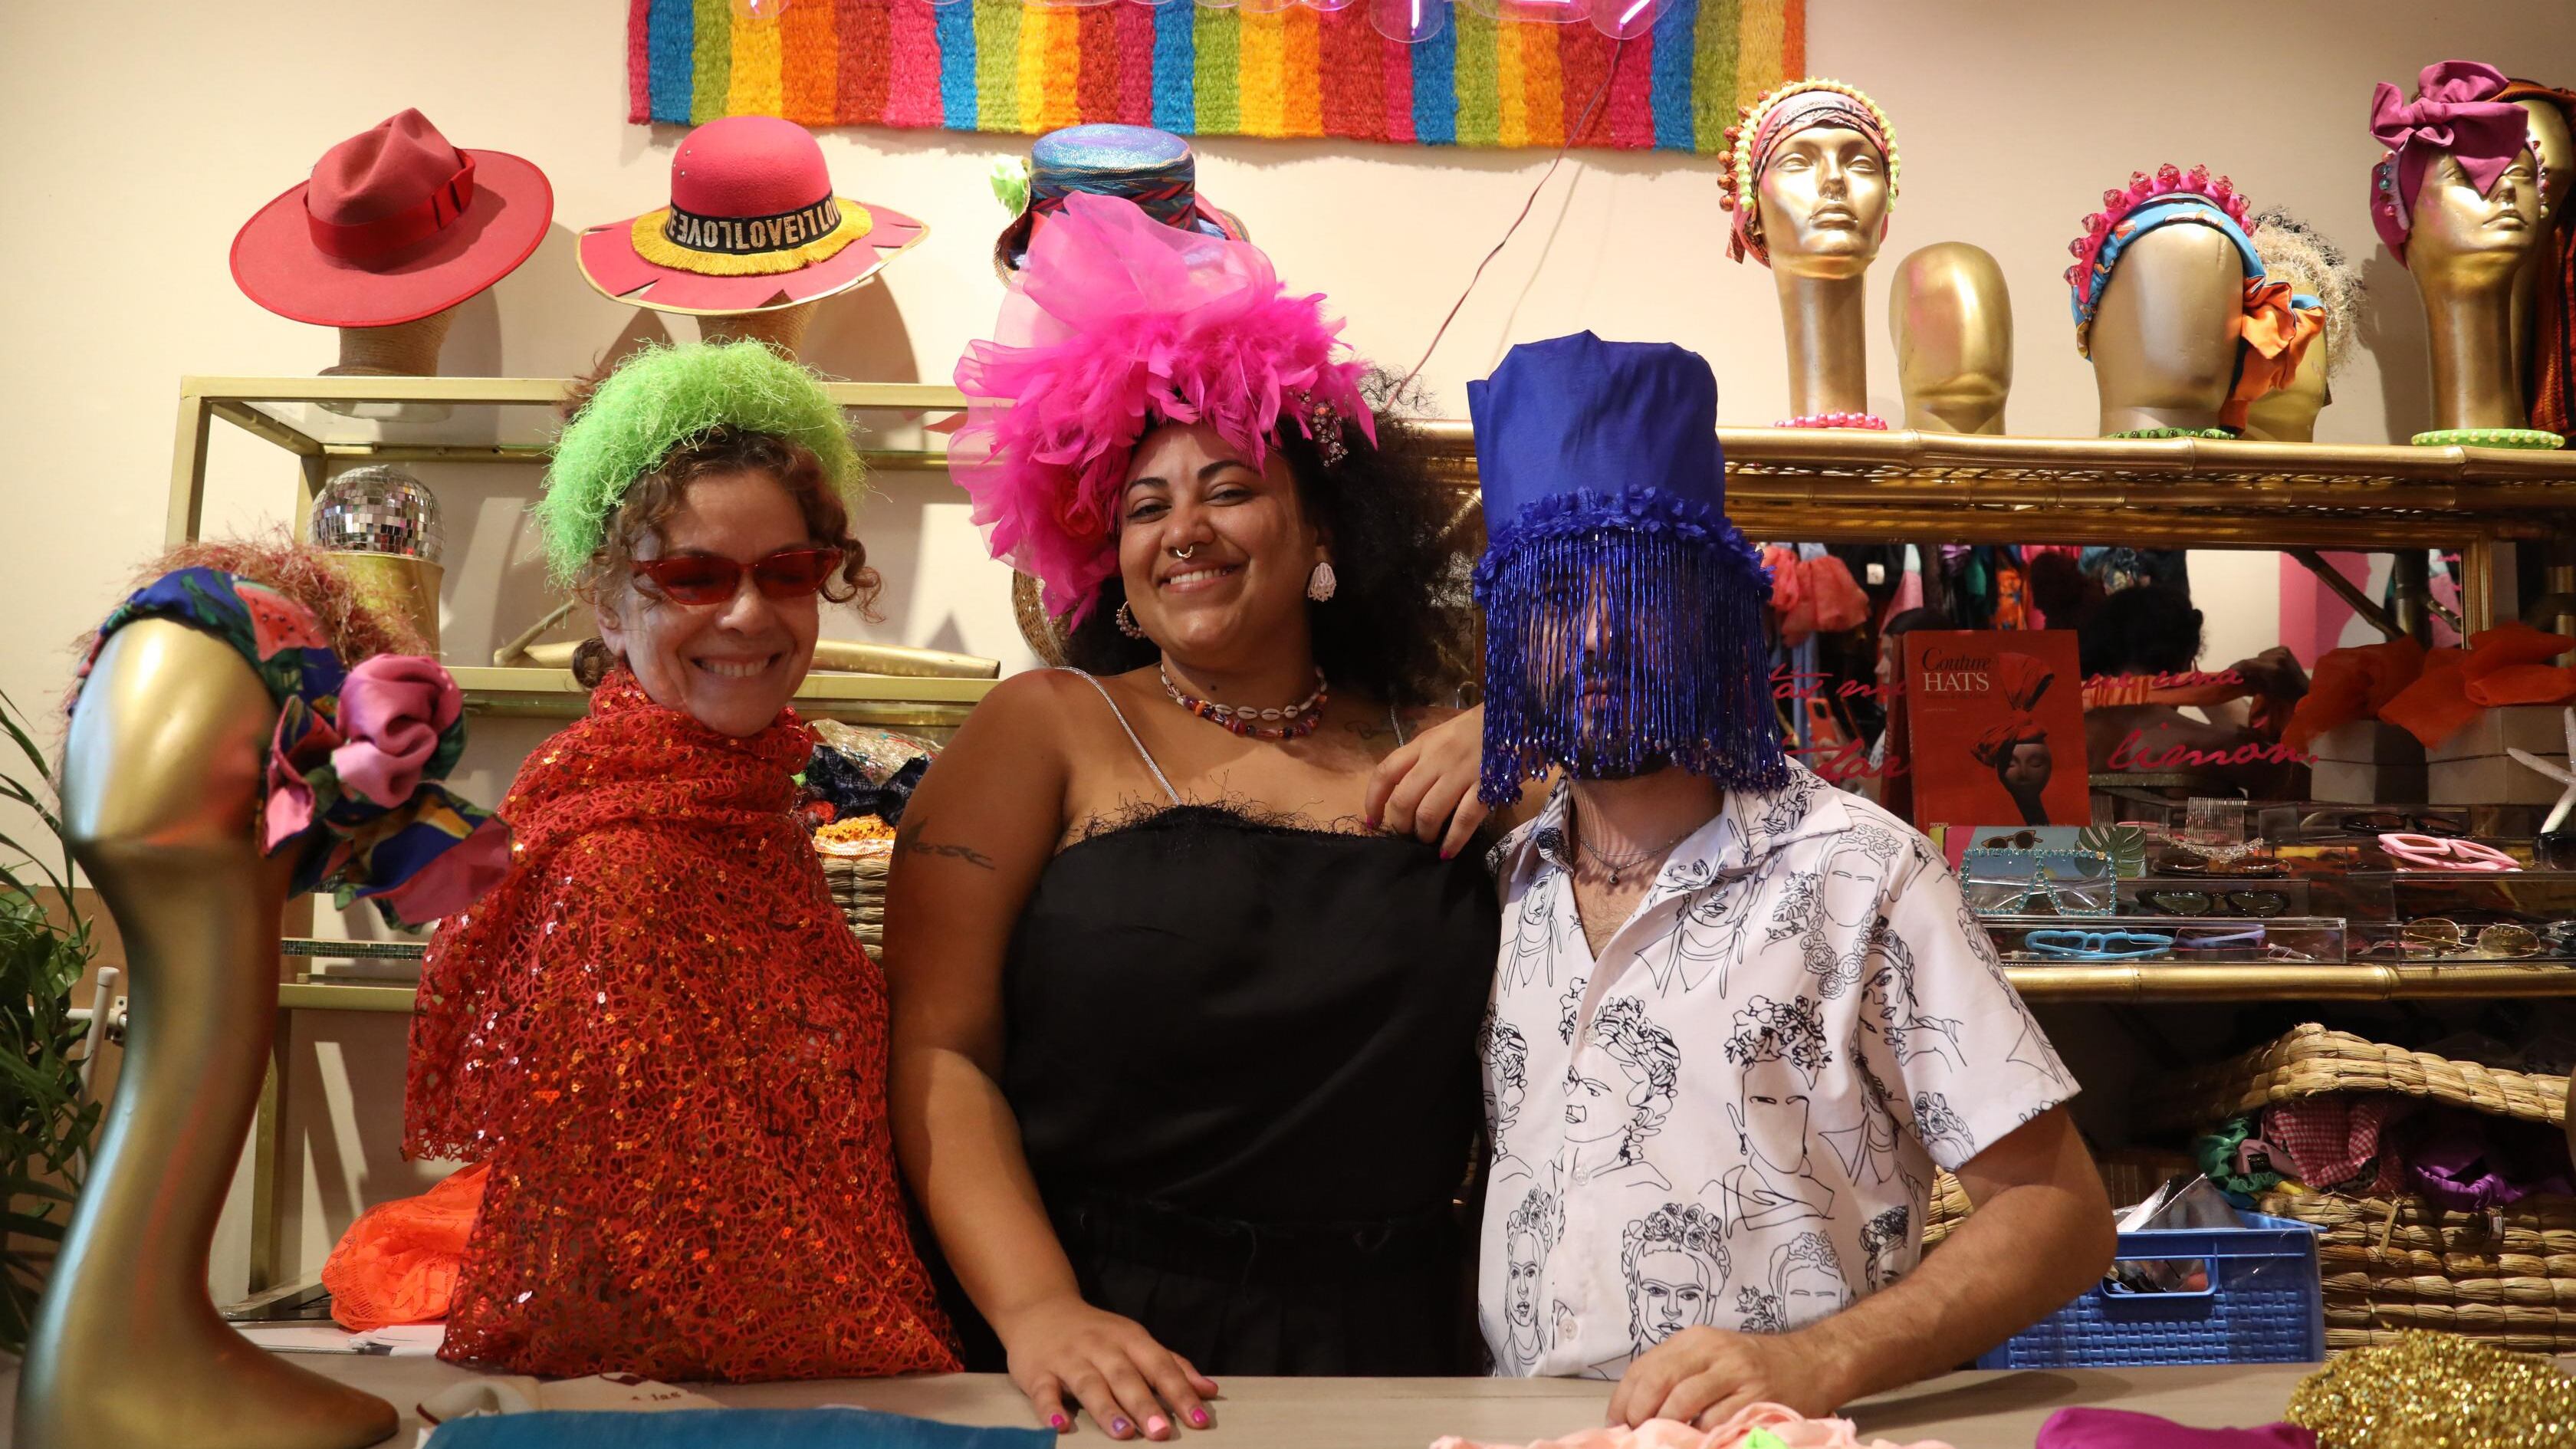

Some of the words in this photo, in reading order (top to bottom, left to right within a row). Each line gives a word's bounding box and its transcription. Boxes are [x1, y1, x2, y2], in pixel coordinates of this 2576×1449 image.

[1922, 647, 1991, 671] Couture
[1923, 672, 1990, 692] HATS
[2151, 669, 2244, 688] una
